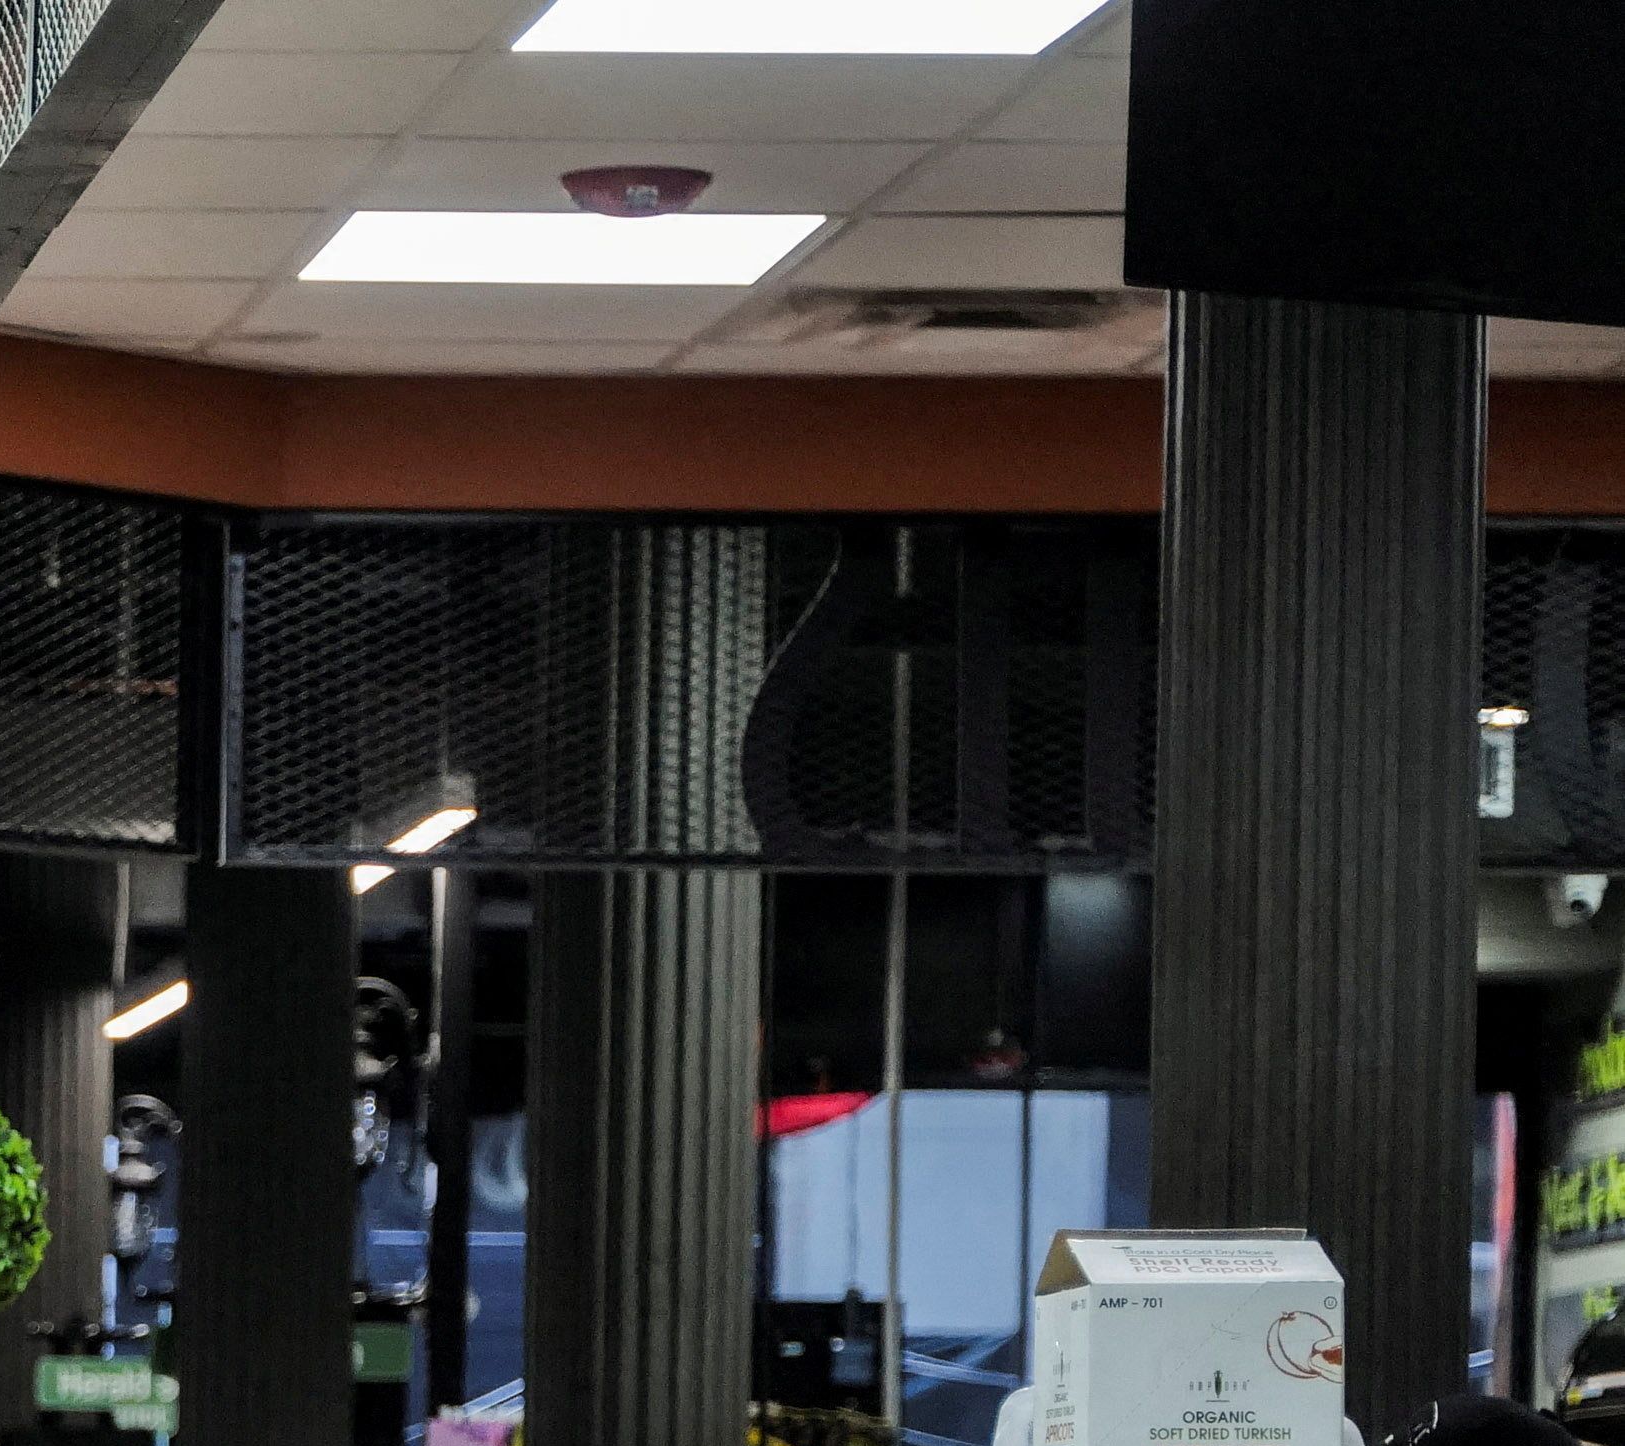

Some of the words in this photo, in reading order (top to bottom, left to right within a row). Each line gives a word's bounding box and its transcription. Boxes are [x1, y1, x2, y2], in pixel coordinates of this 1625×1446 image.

[1128, 1257, 1184, 1268] Shelf
[1201, 1257, 1279, 1269] Ready
[1188, 1264, 1284, 1275] Capable
[1099, 1297, 1129, 1310] AMP
[1142, 1297, 1165, 1310] 701
[1182, 1410, 1256, 1425] ORGANIC
[1045, 1422, 1076, 1445] APRICOTS
[1149, 1427, 1184, 1441] SOFT
[1188, 1427, 1230, 1441] DRIED
[1235, 1427, 1292, 1441] TURKISH
